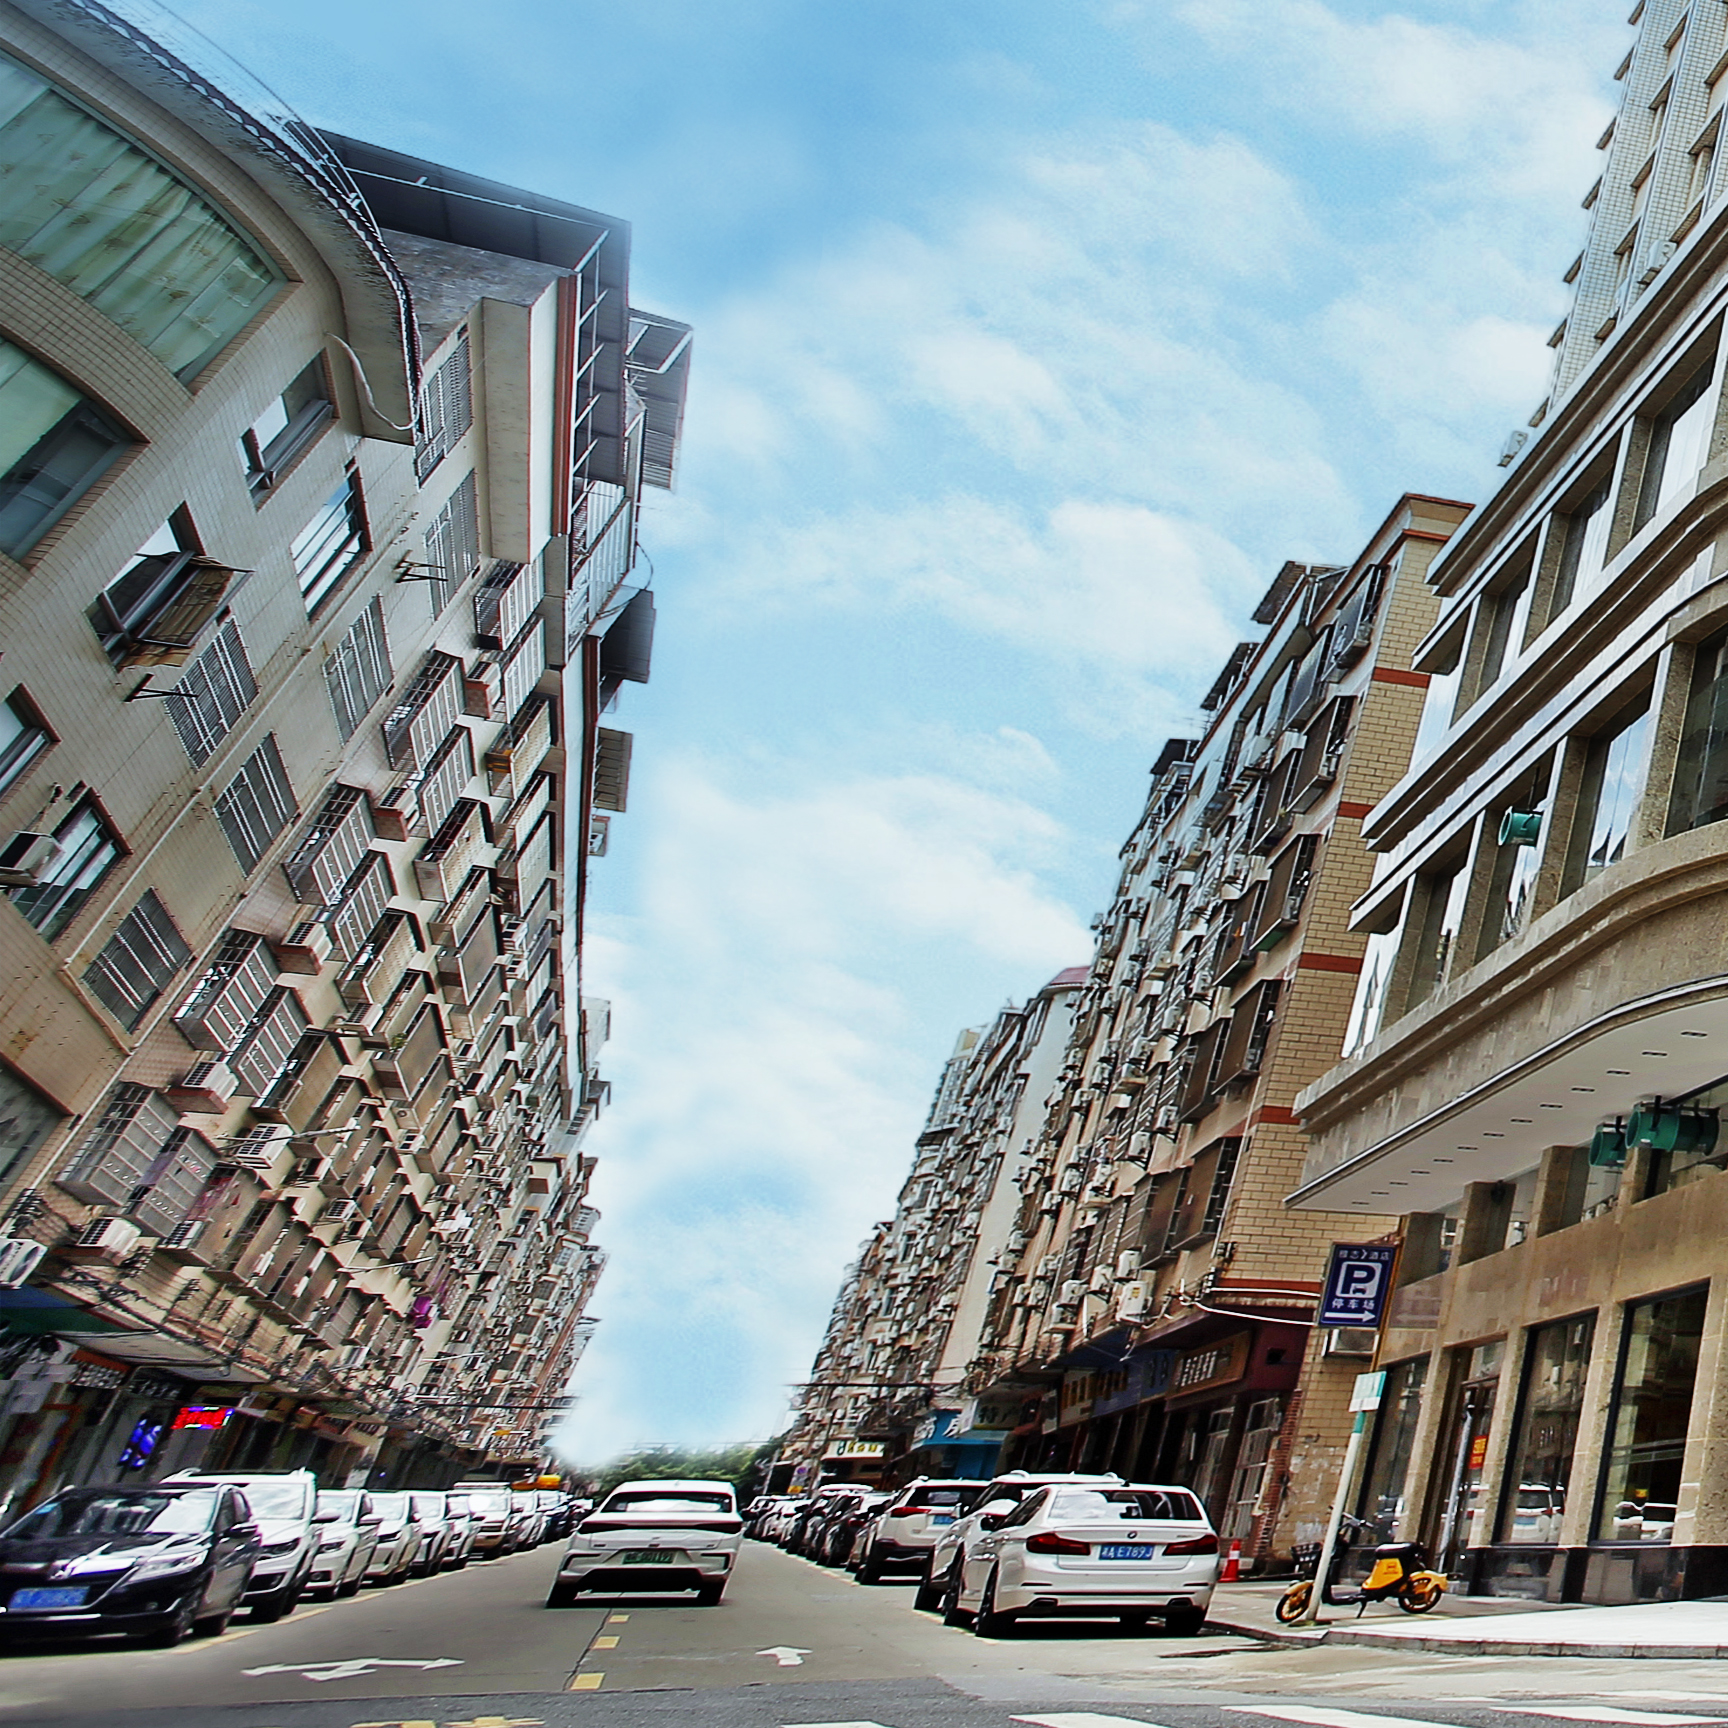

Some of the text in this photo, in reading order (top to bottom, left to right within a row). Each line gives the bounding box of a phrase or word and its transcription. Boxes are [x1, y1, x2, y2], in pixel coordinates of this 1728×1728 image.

[1340, 1263, 1376, 1294] P
[1332, 1298, 1375, 1310] 停车场
